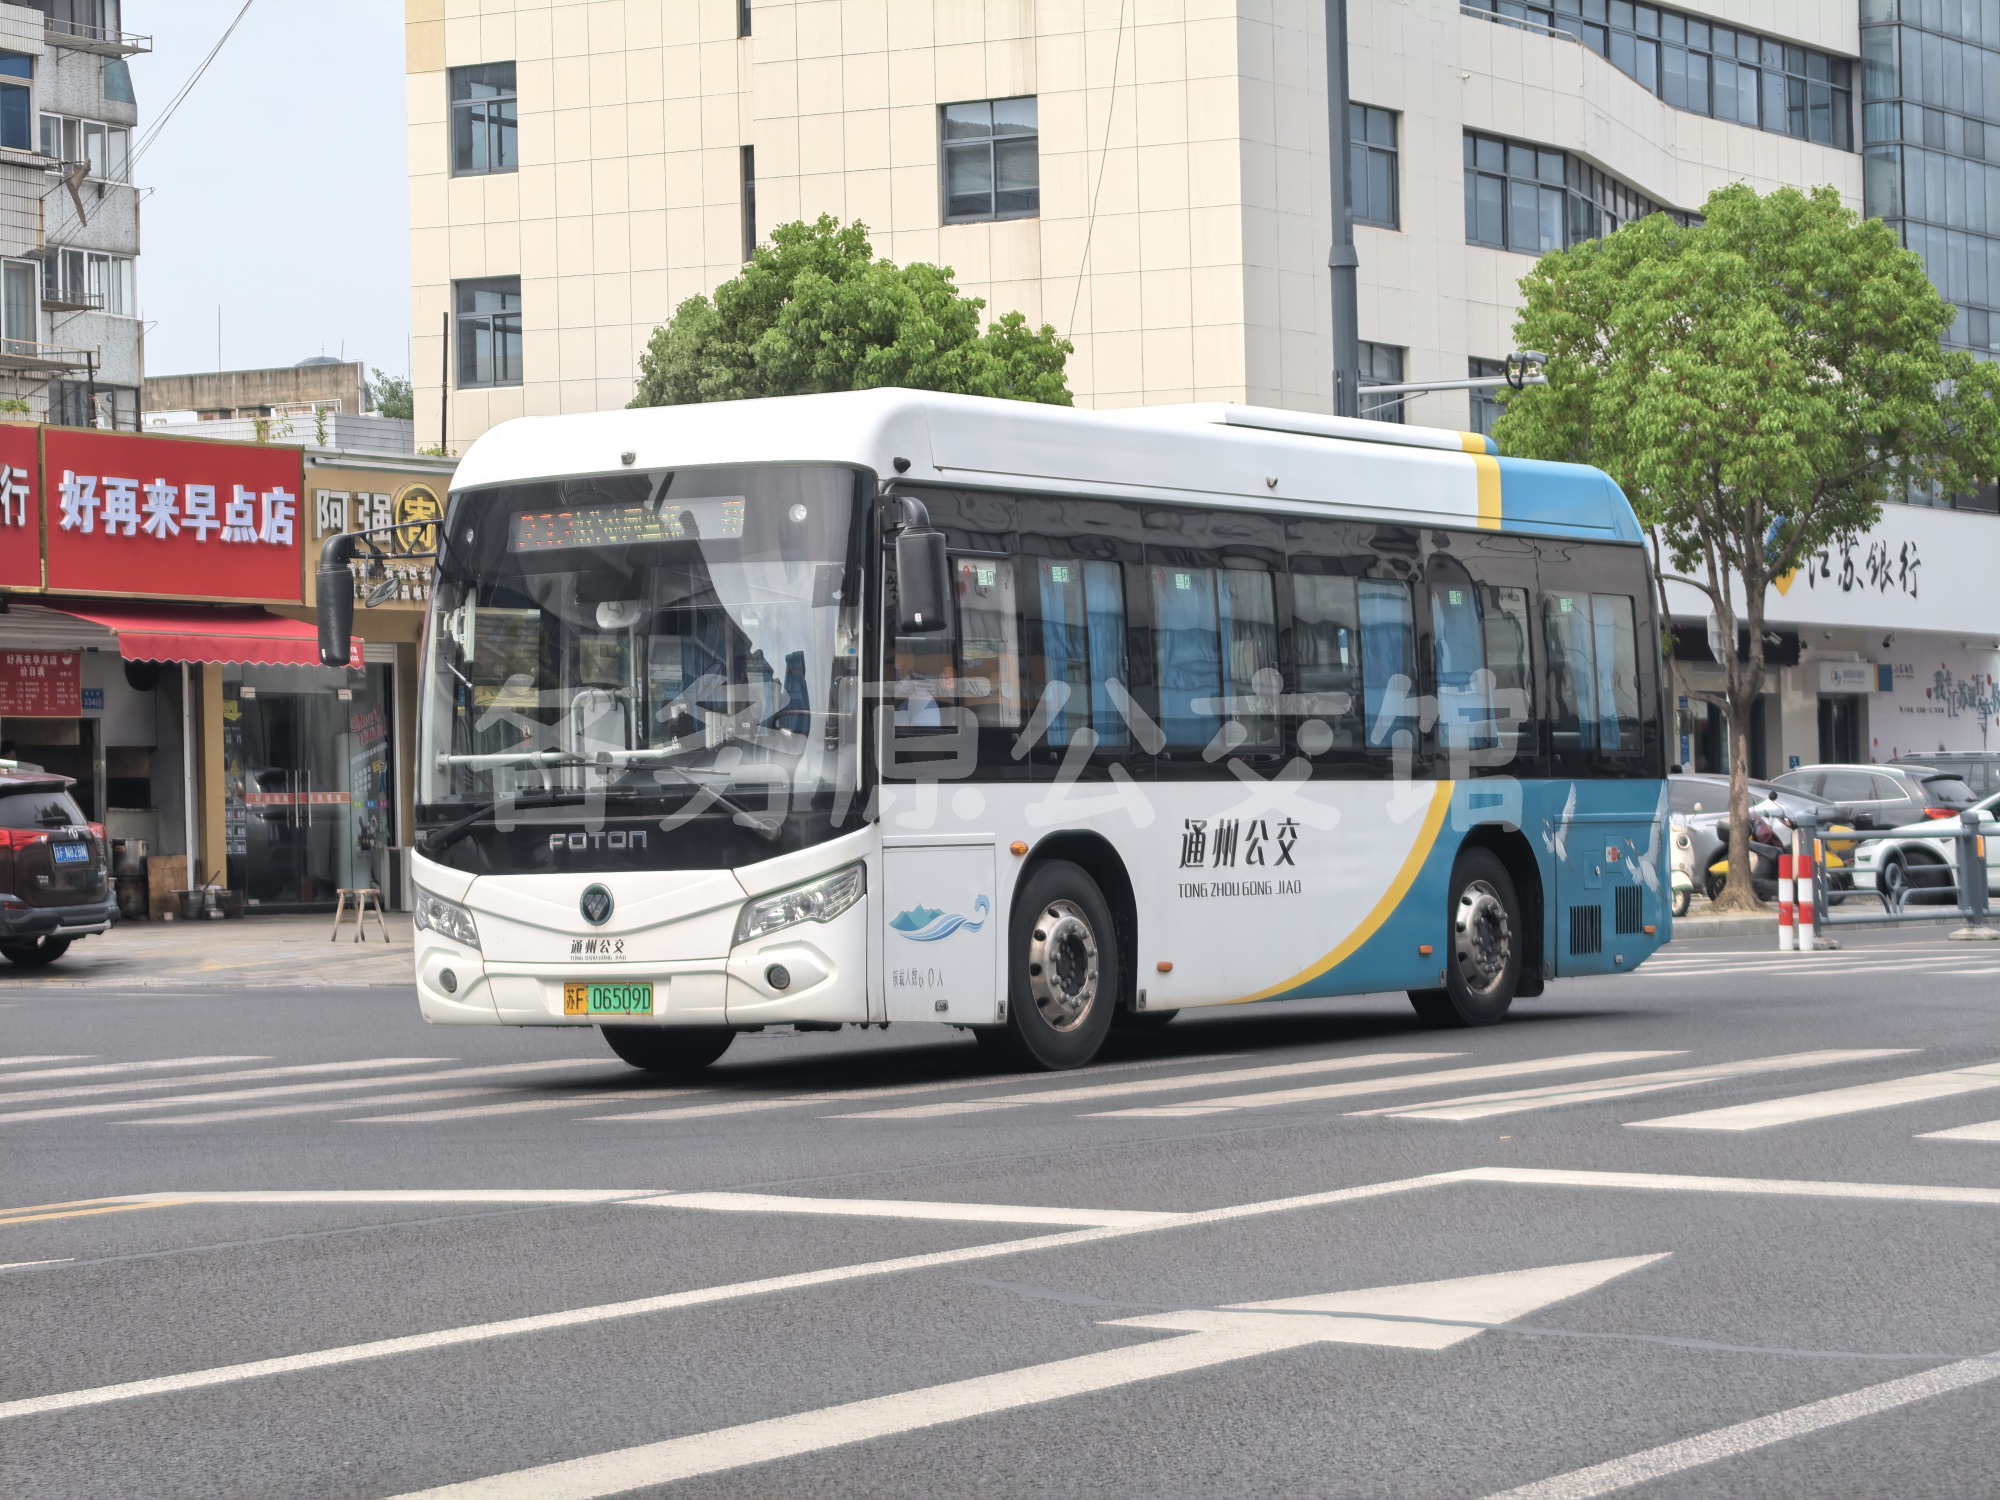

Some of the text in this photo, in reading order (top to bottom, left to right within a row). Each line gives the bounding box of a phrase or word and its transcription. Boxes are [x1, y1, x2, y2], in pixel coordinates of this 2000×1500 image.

[0, 464, 29, 527] 行
[59, 470, 296, 546] 好再来早点店
[6, 654, 57, 665] 好再来早点店
[549, 831, 647, 853] FOTON
[1178, 817, 1300, 868] 通州公交
[1178, 880, 1301, 898] TONG ZHOU GONG JIAO
[570, 939, 626, 954] 通州公交
